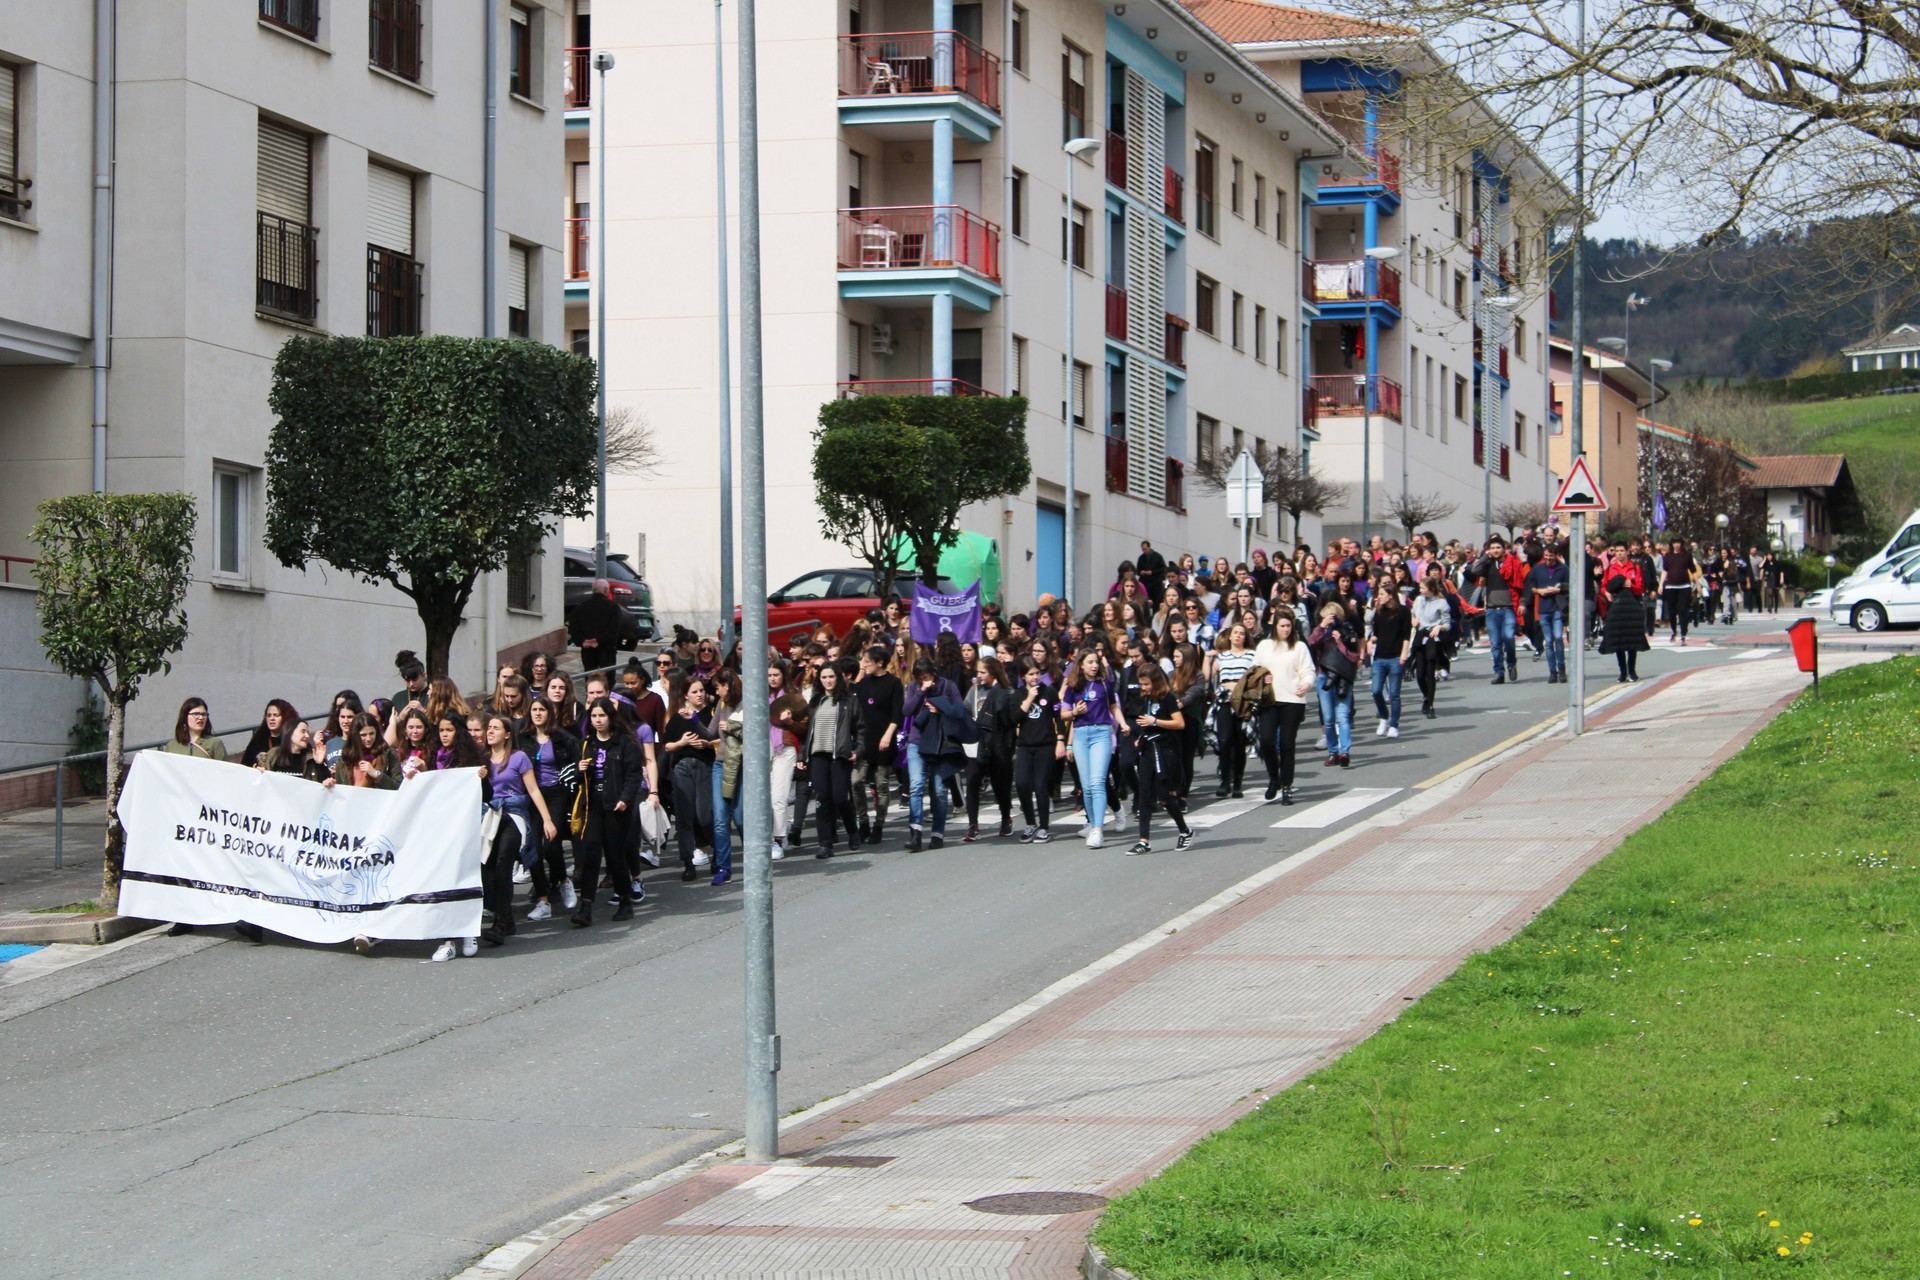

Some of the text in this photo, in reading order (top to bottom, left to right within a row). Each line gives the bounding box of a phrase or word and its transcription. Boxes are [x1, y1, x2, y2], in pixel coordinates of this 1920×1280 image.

[930, 595, 947, 606] GU
[175, 824, 216, 846] BATU
[221, 833, 285, 862] BORROKA
